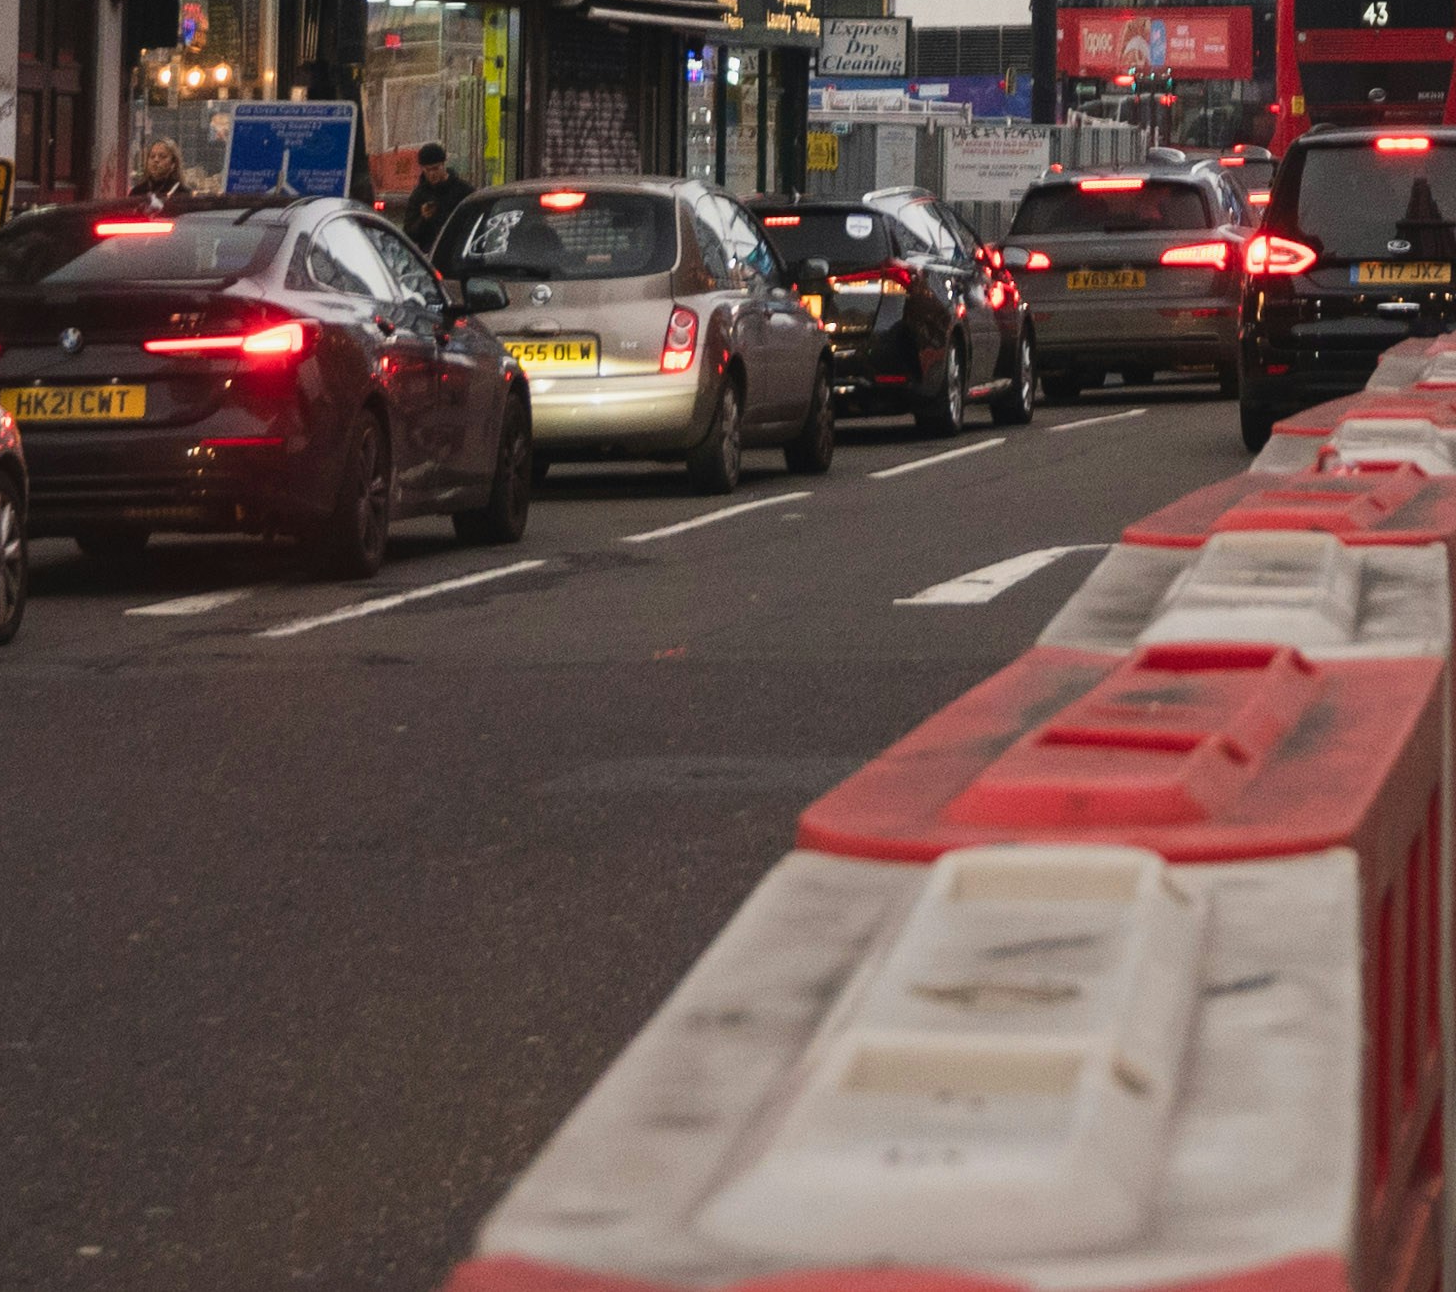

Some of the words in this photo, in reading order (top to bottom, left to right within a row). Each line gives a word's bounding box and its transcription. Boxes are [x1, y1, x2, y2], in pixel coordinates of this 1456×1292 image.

[1362, 1, 1389, 27] 43
[829, 20, 899, 38] Express
[846, 40, 879, 56] Dry
[823, 55, 902, 74] Cleaning
[1366, 263, 1404, 279] YT17
[1411, 262, 1443, 279] JXZ
[554, 343, 591, 360] OLW
[16, 393, 73, 416] HK21
[79, 390, 130, 413] CWT
